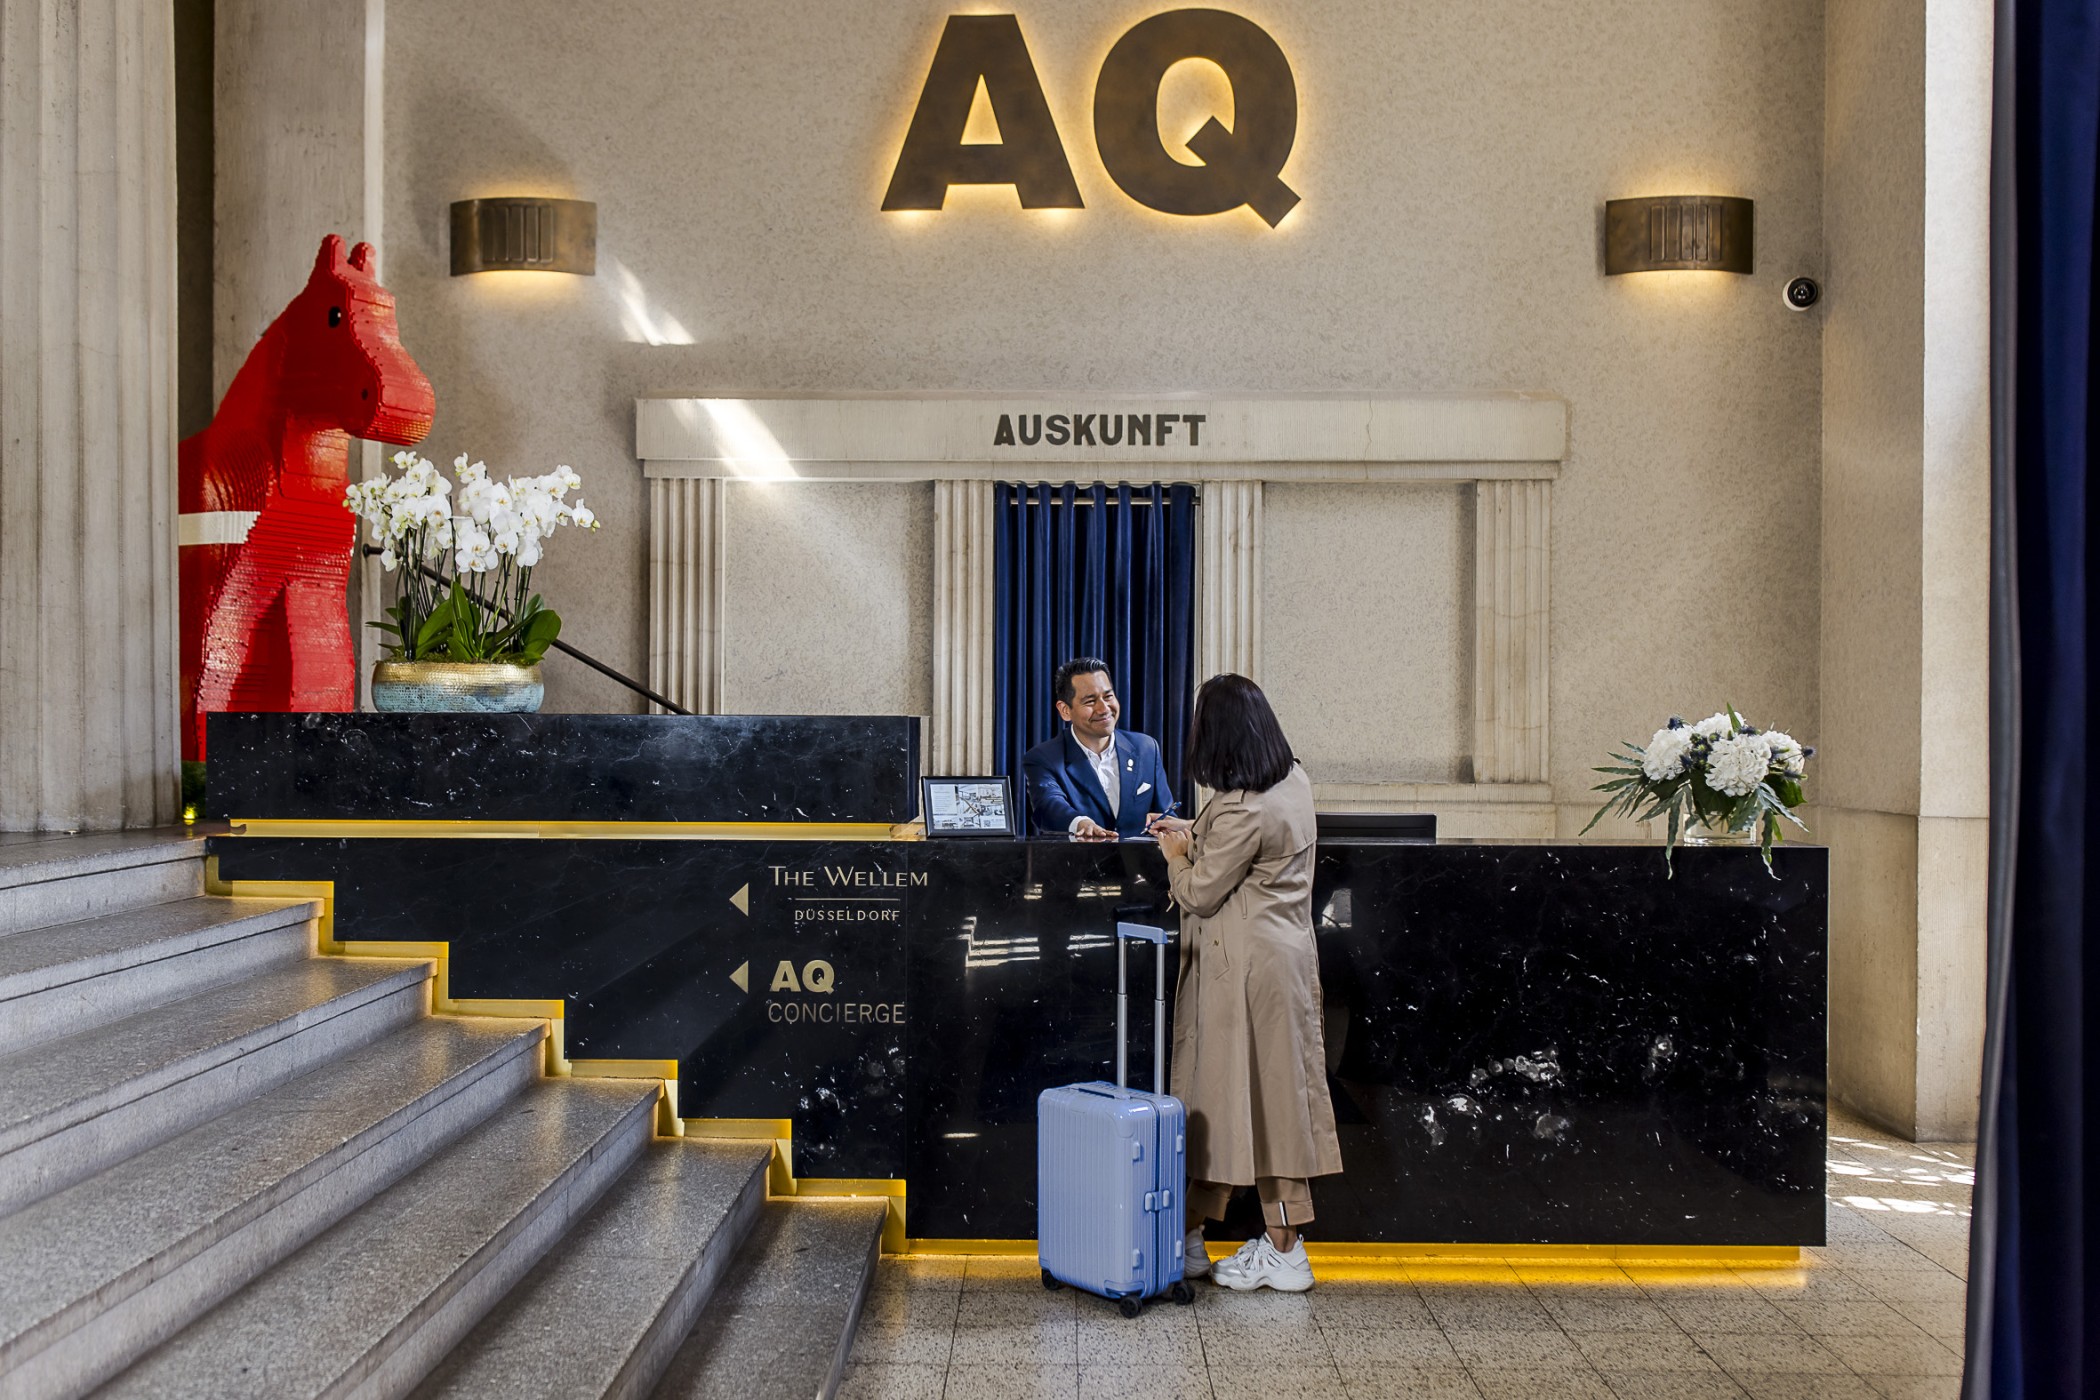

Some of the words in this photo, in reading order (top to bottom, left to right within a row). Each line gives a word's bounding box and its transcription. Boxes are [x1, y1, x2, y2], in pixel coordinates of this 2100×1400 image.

[881, 8, 1301, 229] AQ
[994, 414, 1206, 446] AUSKUNFT
[794, 908, 901, 921] DÜSSELDORF
[770, 959, 835, 995] AQ
[768, 1003, 906, 1024] CONCIERGE
